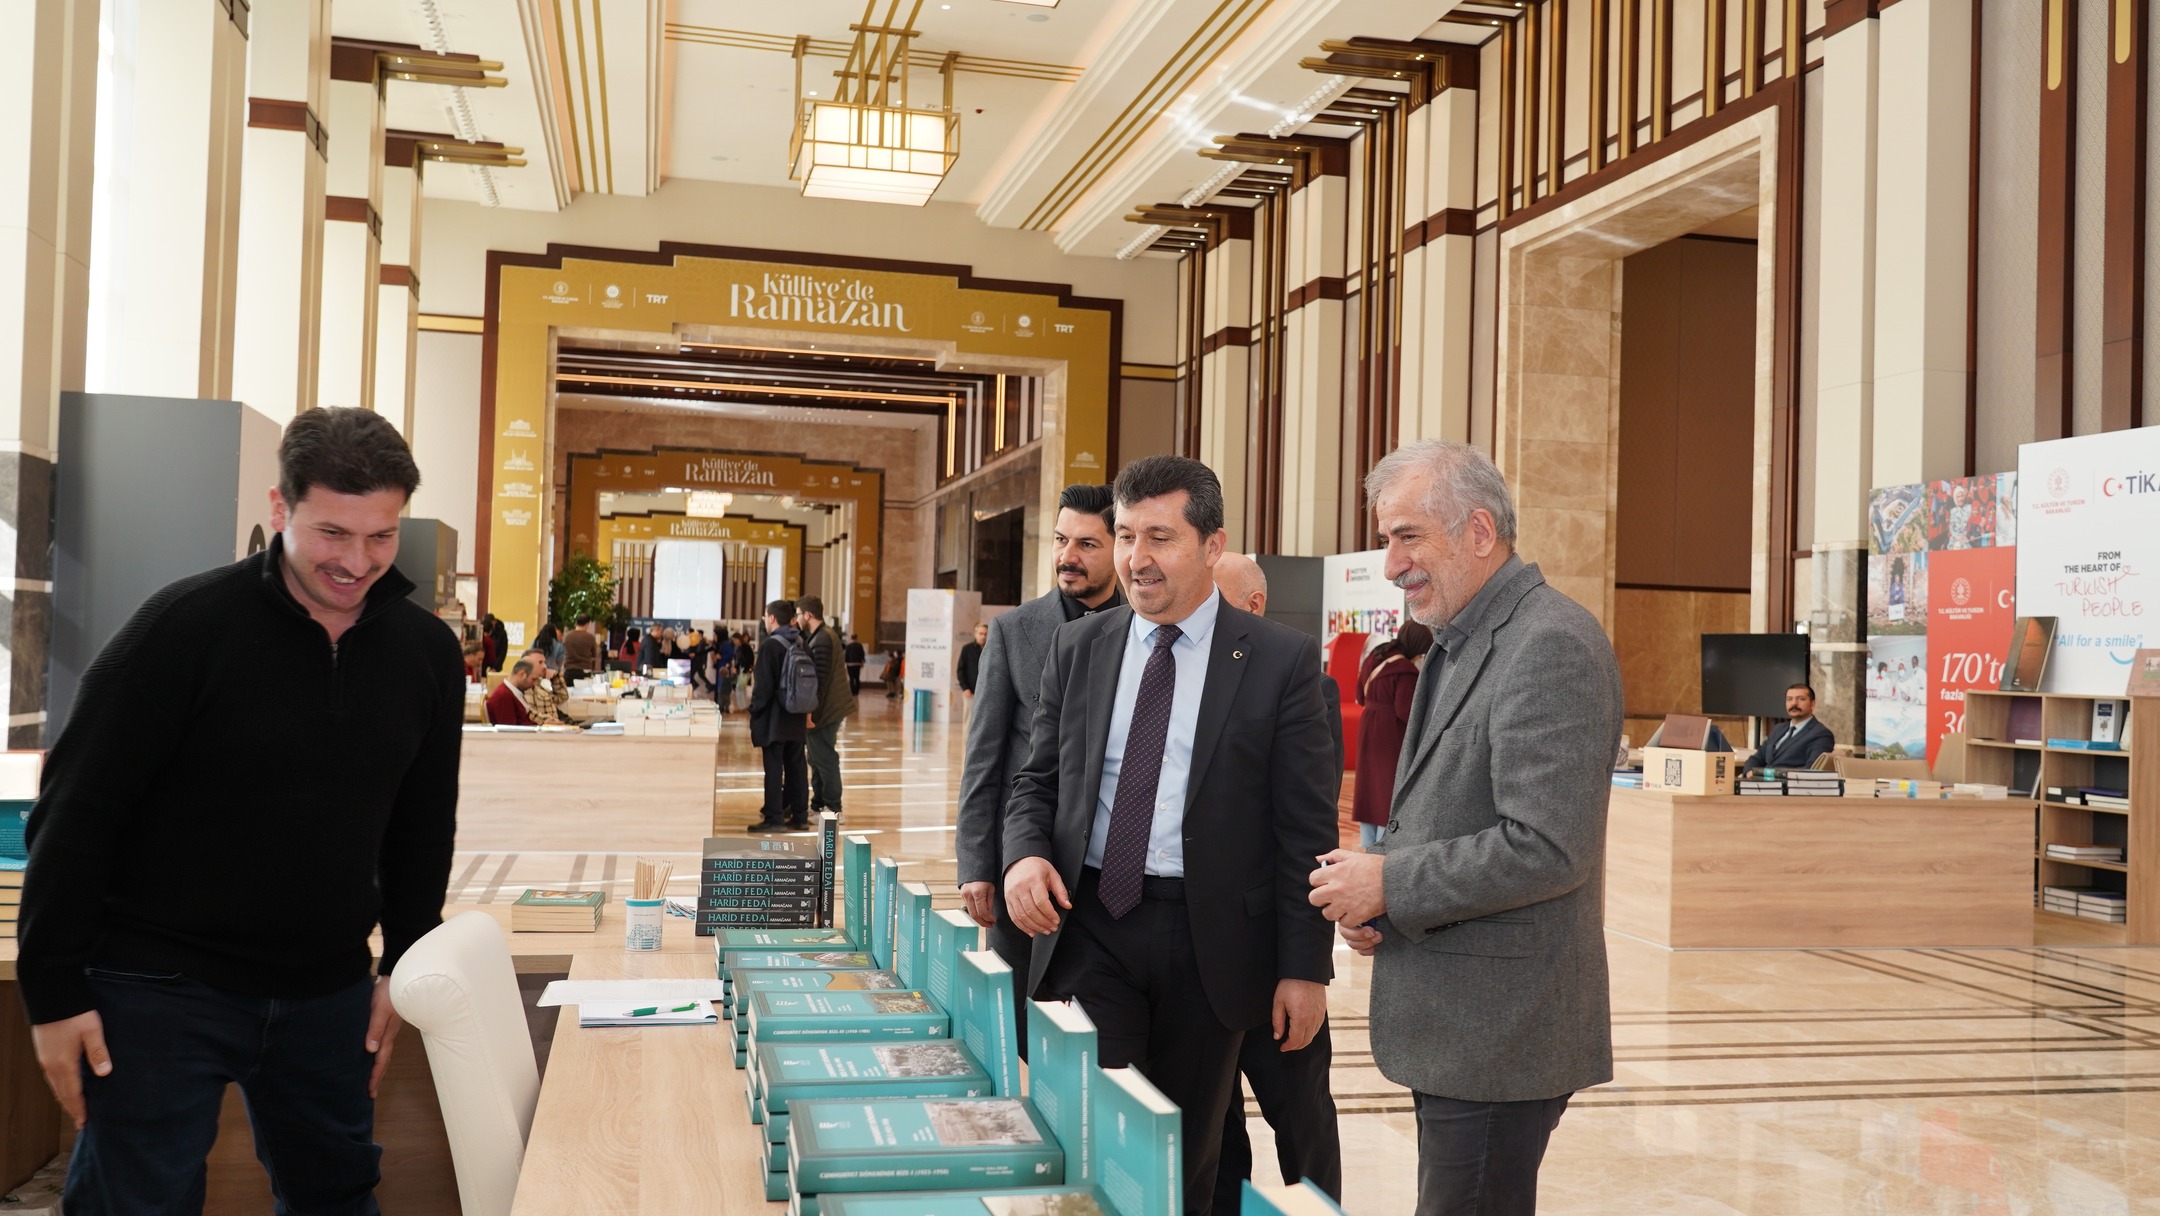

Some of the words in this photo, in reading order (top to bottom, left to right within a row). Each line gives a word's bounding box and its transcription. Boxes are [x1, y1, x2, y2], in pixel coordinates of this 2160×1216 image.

[646, 293, 668, 304] TRT
[730, 283, 912, 332] Ramazan
[1054, 324, 1075, 333] TRT
[685, 462, 776, 487] Ramazan
[2125, 470, 2160, 494] TİK
[670, 522, 731, 538] Ramazan
[2097, 551, 2121, 560] FROM
[2064, 565, 2079, 574] THE
[2081, 563, 2108, 573] HEART
[2110, 563, 2121, 571] OF
[2055, 576, 2119, 596] TURKISH
[2082, 597, 2143, 616] PEOPLE
[2076, 634, 2092, 647] for
[2095, 638, 2102, 647] a
[826, 829, 835, 859] HARİD
[714, 858, 744, 869] HARİD
[746, 859, 775, 869] FEDAİ
[713, 871, 742, 882] HARİD
[745, 872, 774, 882] FEDAİ
[824, 861, 833, 890] FEDAİ
[712, 885, 742, 895] HARİD
[744, 885, 773, 895] FEDAİ
[709, 897, 739, 907] HARİD
[741, 898, 771, 907] FEDAİ
[708, 912, 737, 922] HARİD
[740, 912, 769, 922] FEDAİ
